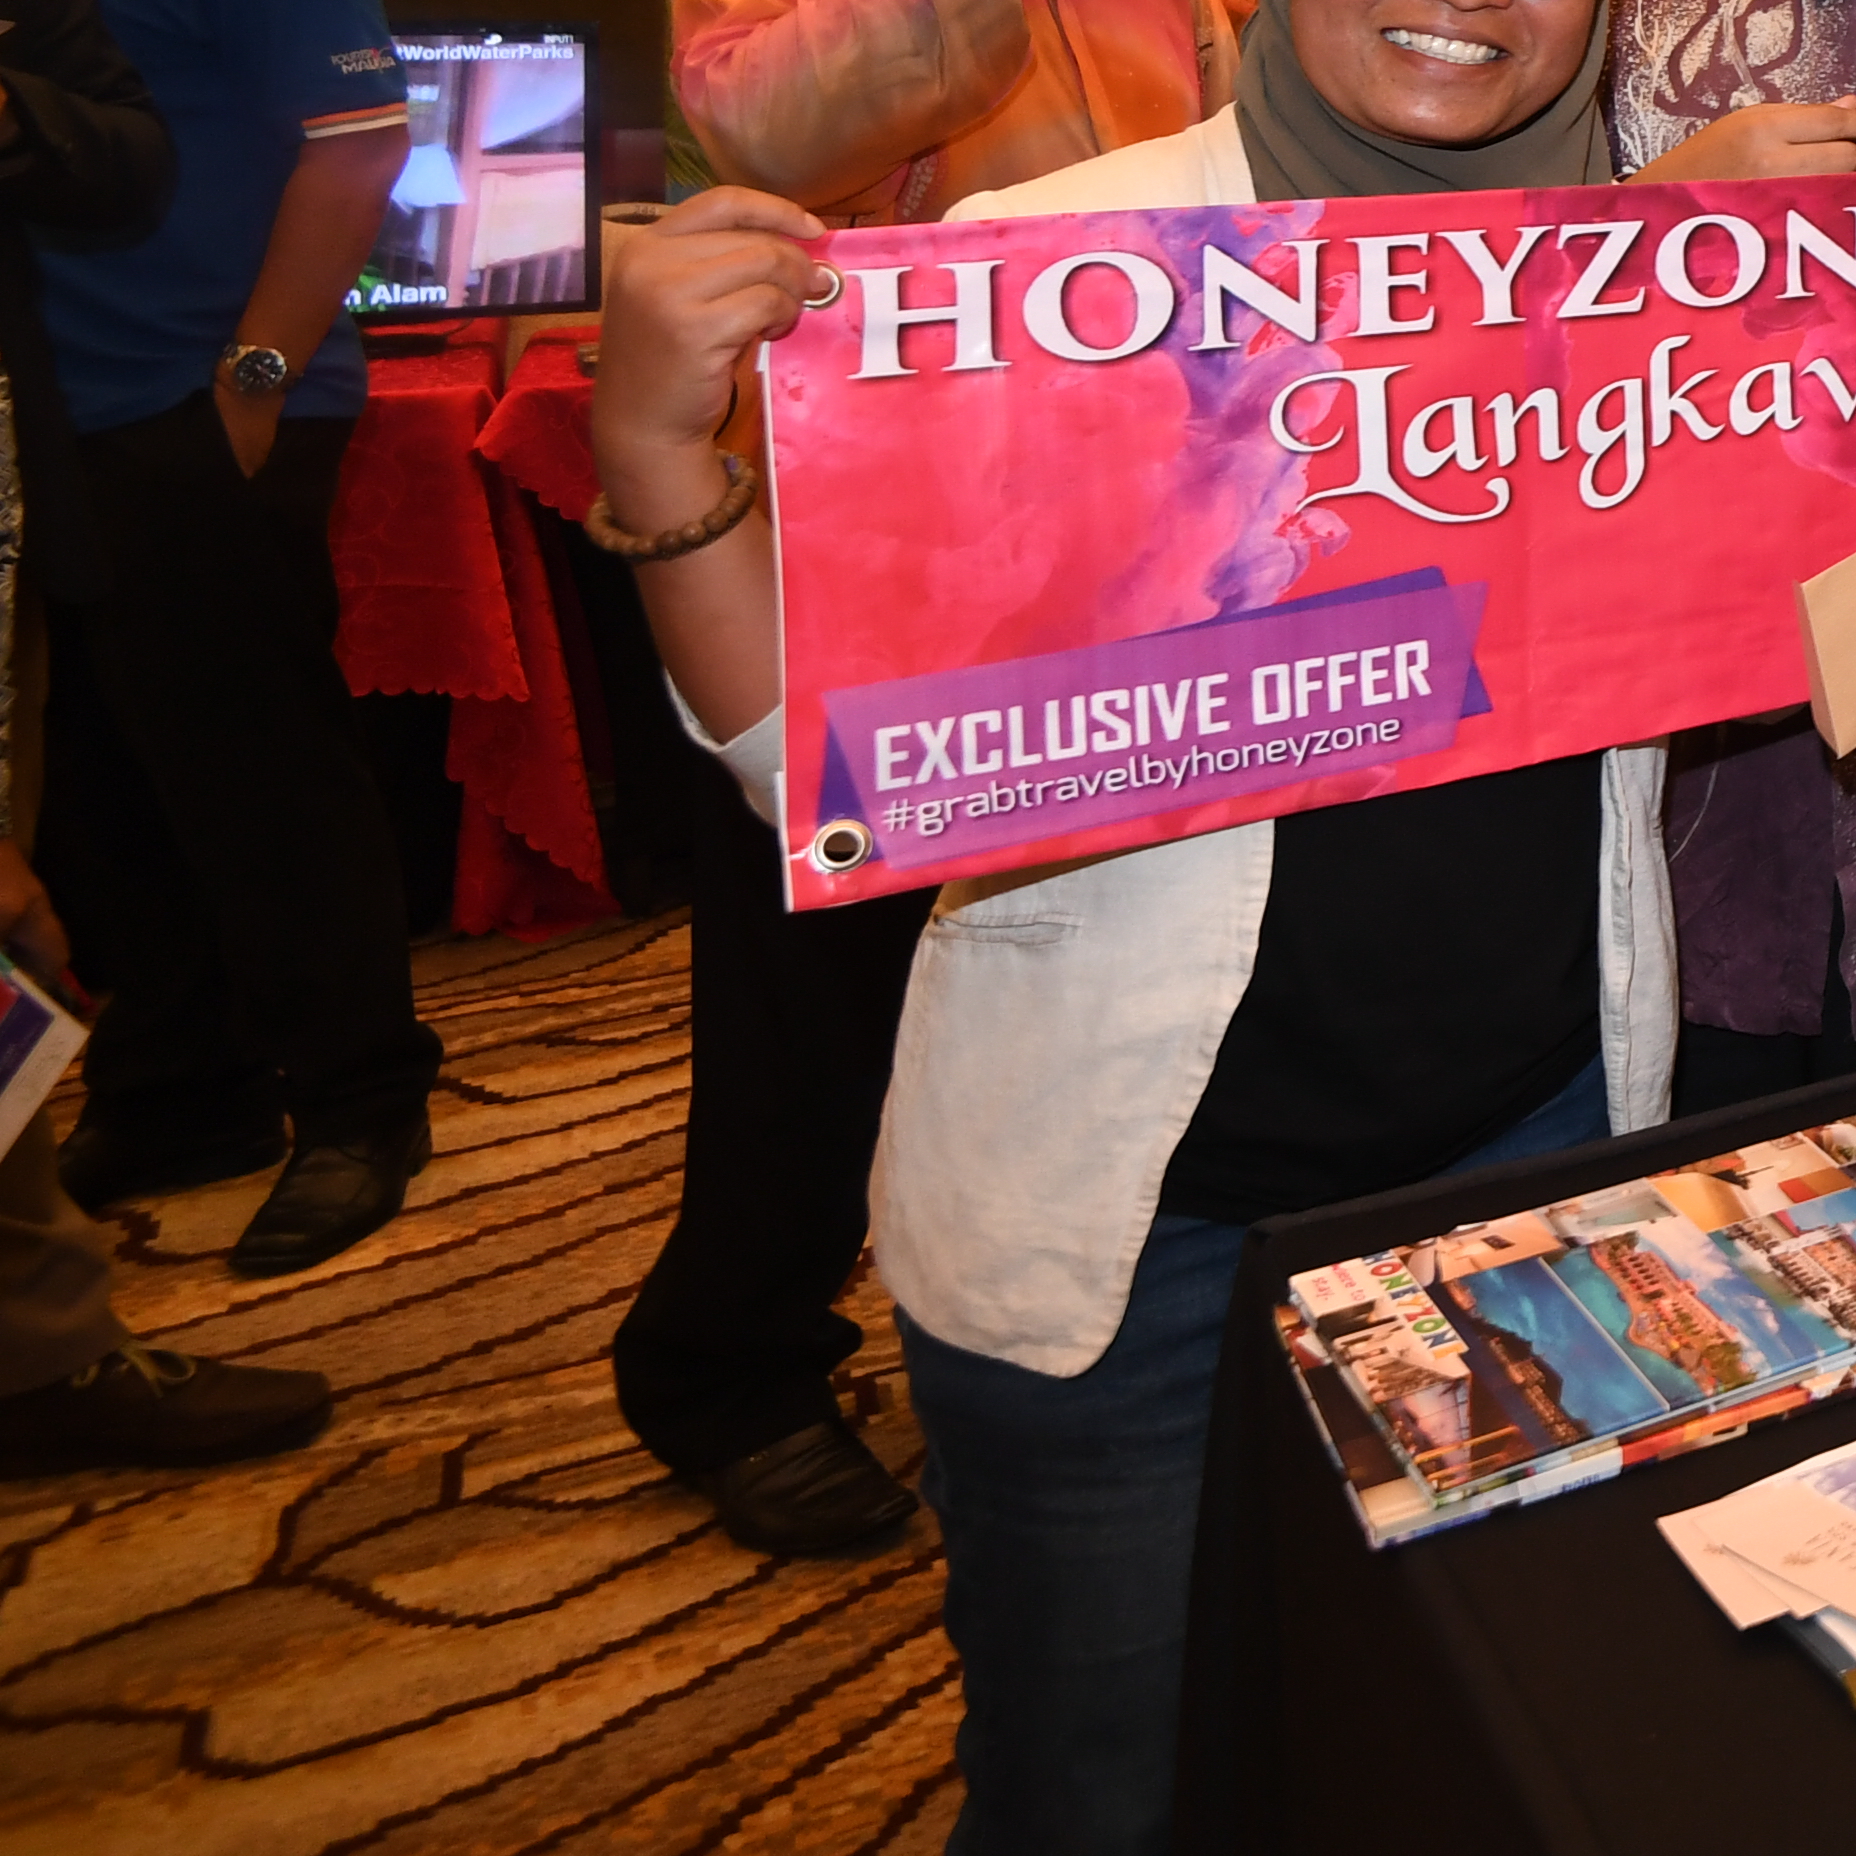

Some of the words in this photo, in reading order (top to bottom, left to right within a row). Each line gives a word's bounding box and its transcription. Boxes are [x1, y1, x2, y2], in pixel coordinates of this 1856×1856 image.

[371, 283, 447, 305] Alam
[873, 675, 1231, 792] EXCLUSIVE
[1250, 640, 1431, 725] OFFER
[881, 715, 1402, 838] #grabtravelbyhoneyzone
